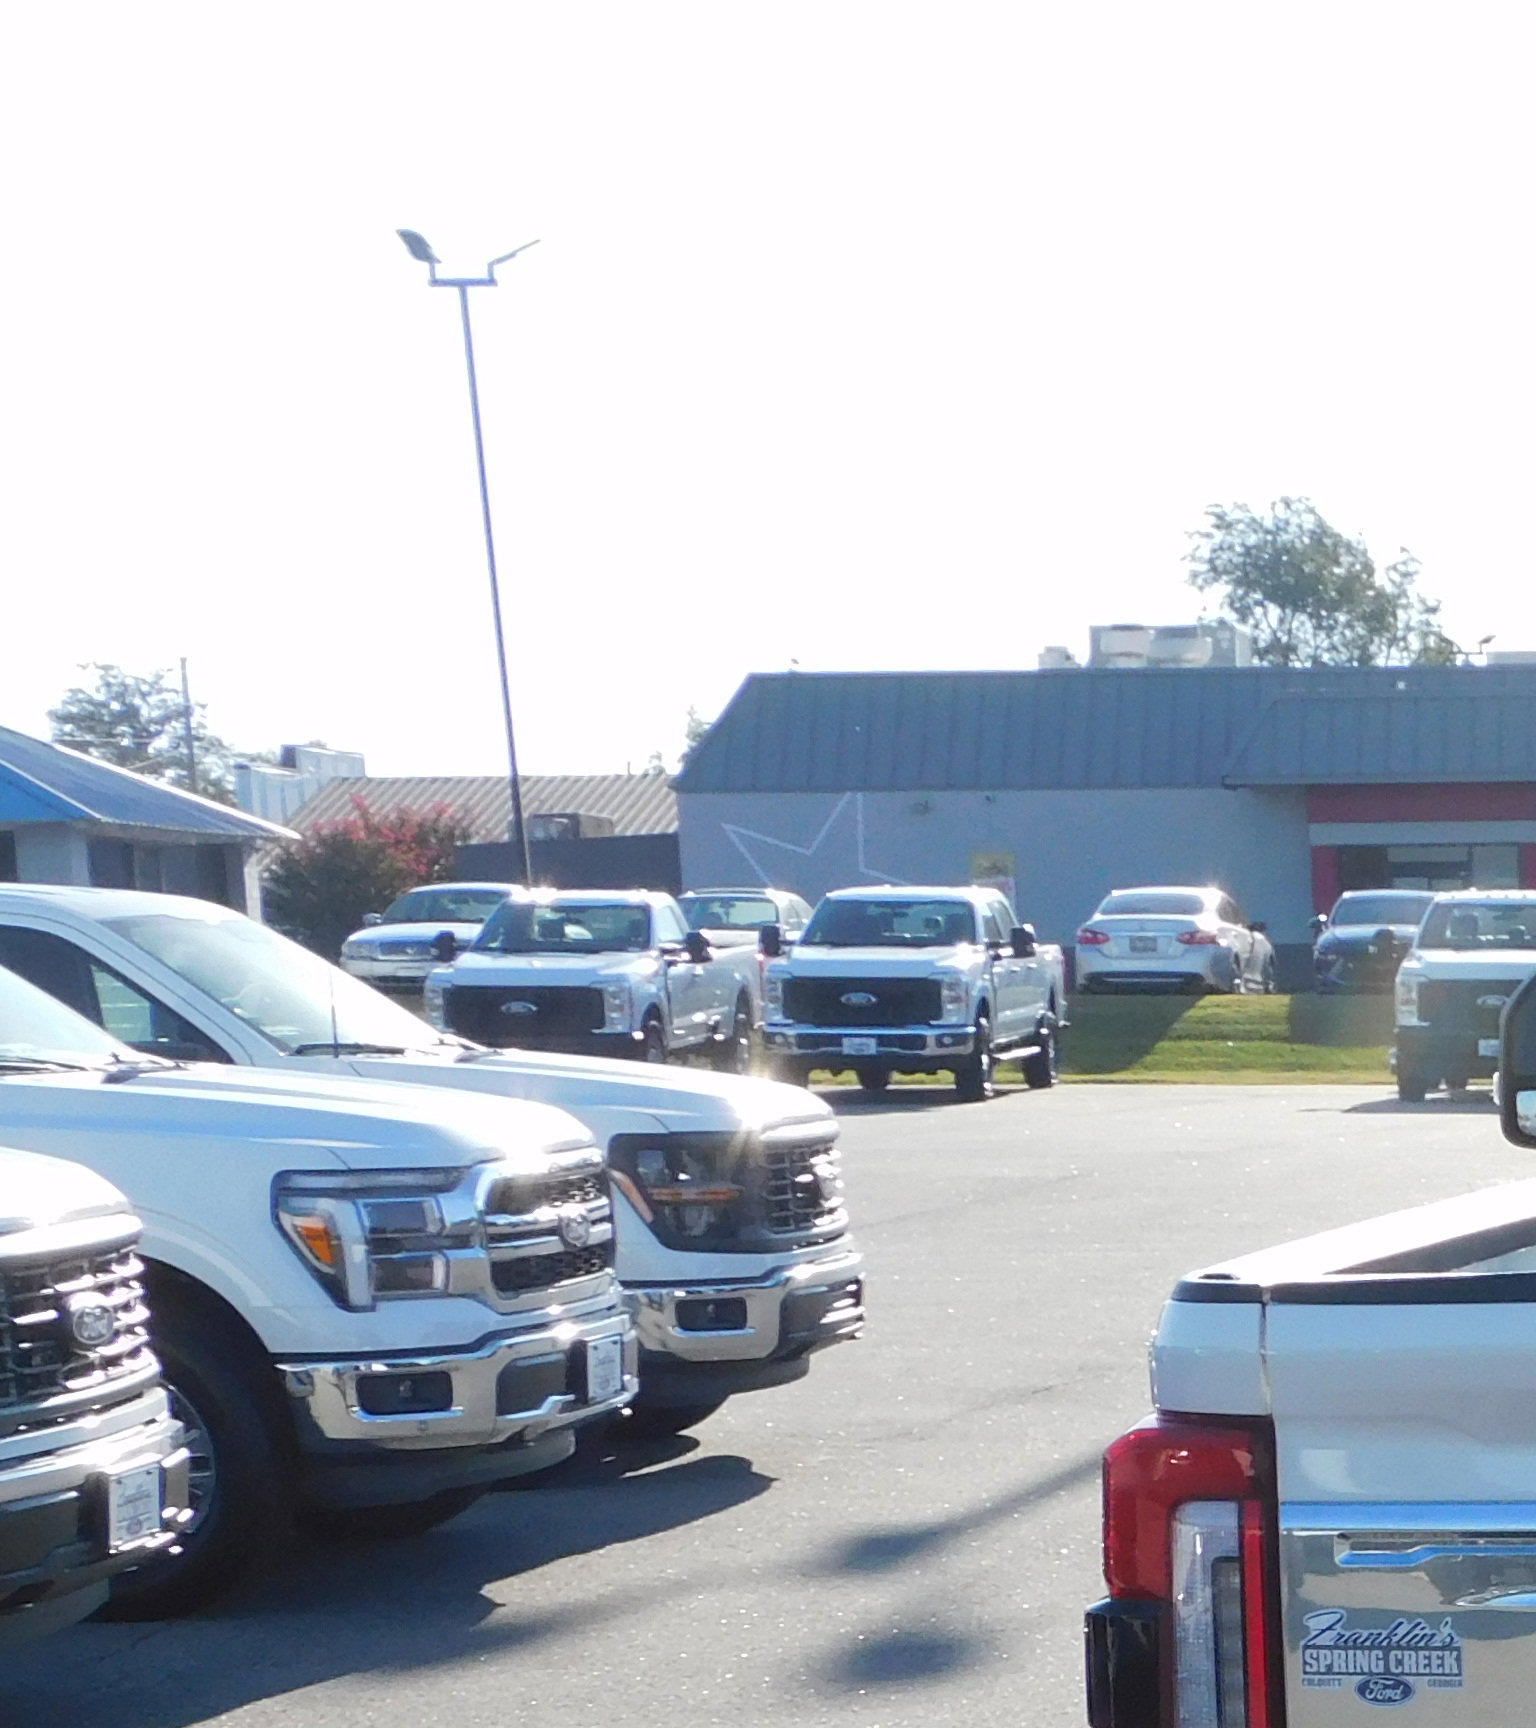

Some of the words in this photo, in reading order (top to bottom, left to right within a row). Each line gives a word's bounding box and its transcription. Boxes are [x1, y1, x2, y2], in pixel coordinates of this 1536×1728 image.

[1304, 1611, 1458, 1648] Franklin's
[1304, 1650, 1385, 1674] SPRING
[1388, 1650, 1460, 1675] CREEK
[1365, 1679, 1403, 1700] Ford
